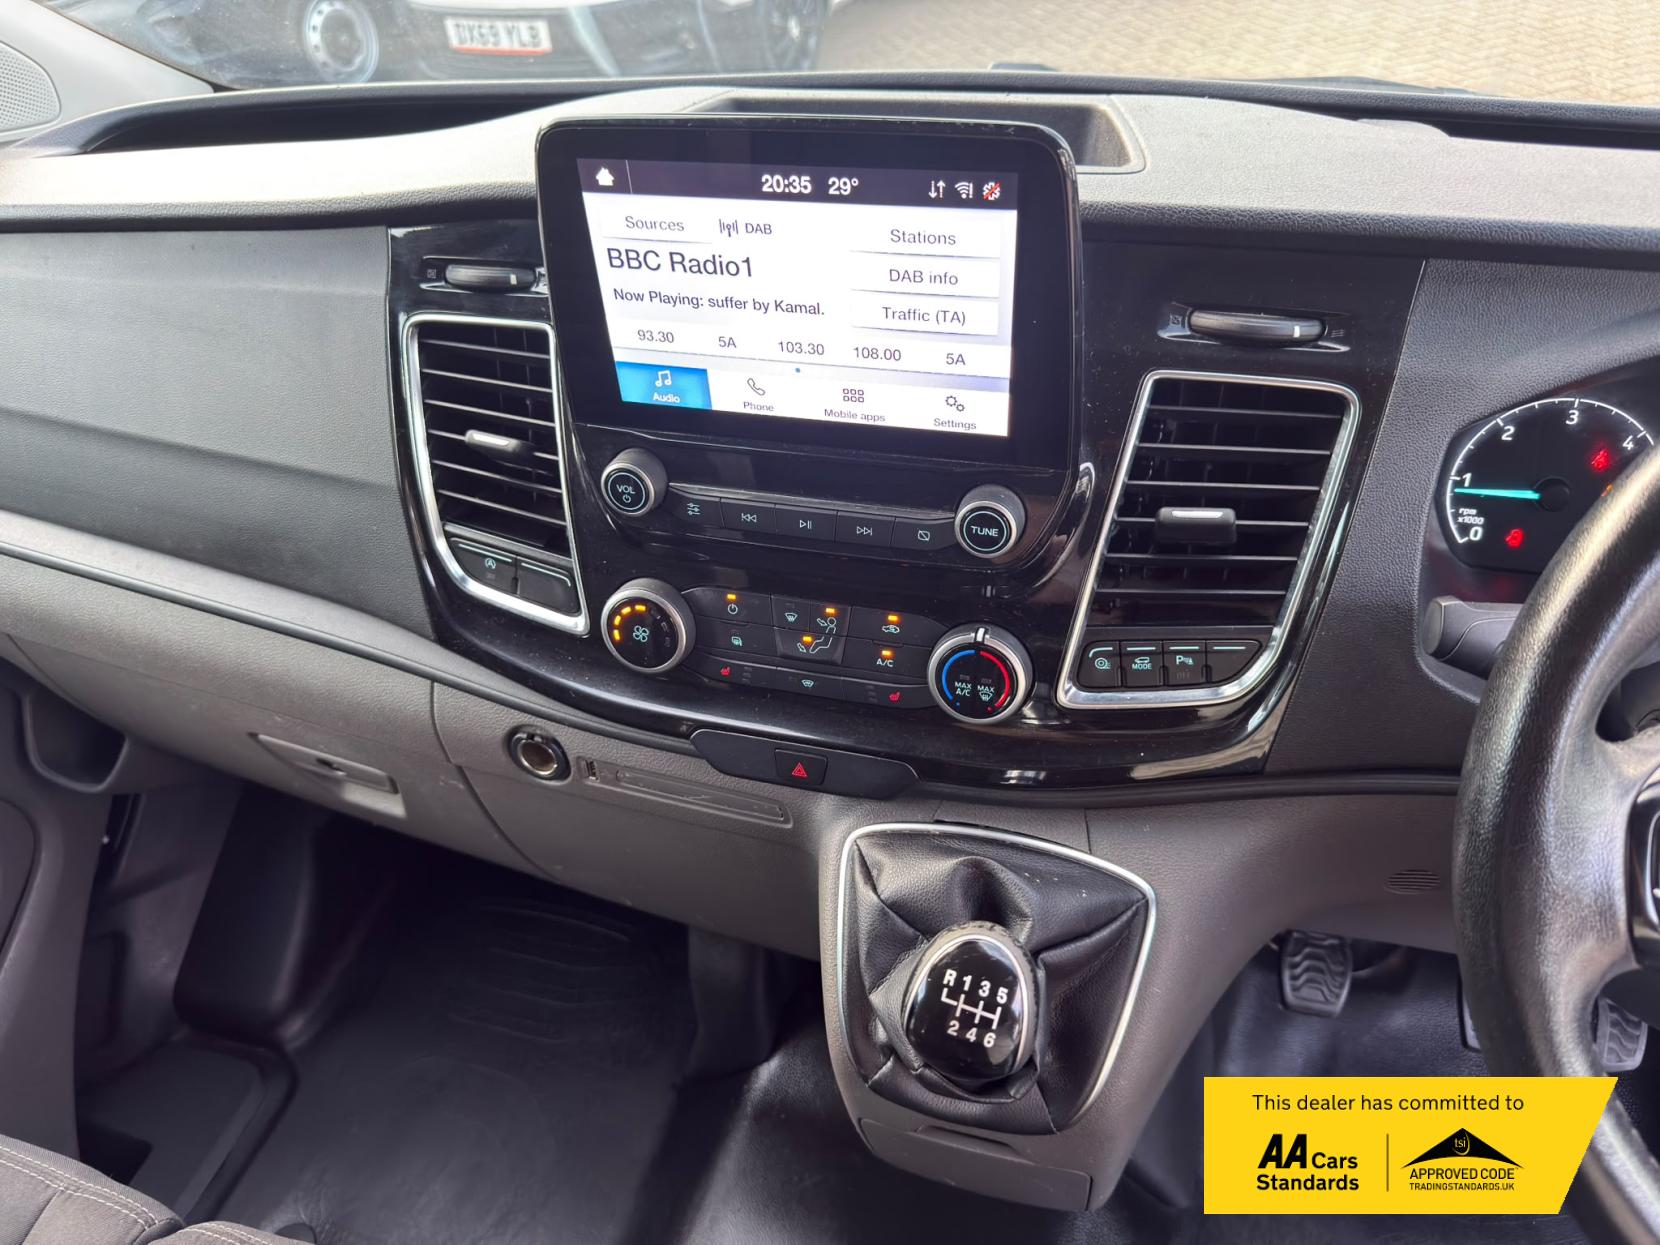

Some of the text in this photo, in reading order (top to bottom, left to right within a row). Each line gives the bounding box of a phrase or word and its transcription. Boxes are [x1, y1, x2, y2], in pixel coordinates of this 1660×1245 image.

[761, 174, 812, 194] 20:35
[828, 176, 859, 196] 29°
[624, 215, 685, 232] Sources
[745, 222, 773, 235] DAB
[890, 228, 956, 246] Stations
[607, 247, 752, 278] BBC Radio1
[889, 268, 959, 286] DAB info
[613, 287, 825, 316] Now Playing: suffer by Kamal.
[882, 306, 966, 326] Traffic (TA)
[637, 328, 674, 343] 93.30
[718, 336, 737, 349] 5A
[778, 340, 825, 356] 103.30
[853, 346, 902, 362] 108.00
[946, 353, 966, 366] 5A
[652, 391, 680, 404] Audio
[743, 401, 774, 412] Phone
[824, 408, 886, 423] Mobile apps
[1565, 409, 1580, 425] 3
[933, 417, 977, 431] Settings
[1501, 425, 1515, 441] 2
[1622, 435, 1634, 450] 4
[1461, 472, 1472, 488] 1
[616, 483, 635, 495] VOL
[1458, 507, 1477, 516] rpm
[1457, 516, 1485, 525] x1000
[970, 525, 999, 537] TUNE
[1469, 525, 1483, 541] 0
[876, 658, 894, 668] A/C
[954, 681, 972, 689] MAX
[955, 688, 971, 697] A/C
[977, 685, 995, 693] MAX
[942, 968, 1009, 1004] R 1 3 5
[947, 1020, 997, 1048] 2 4 6
